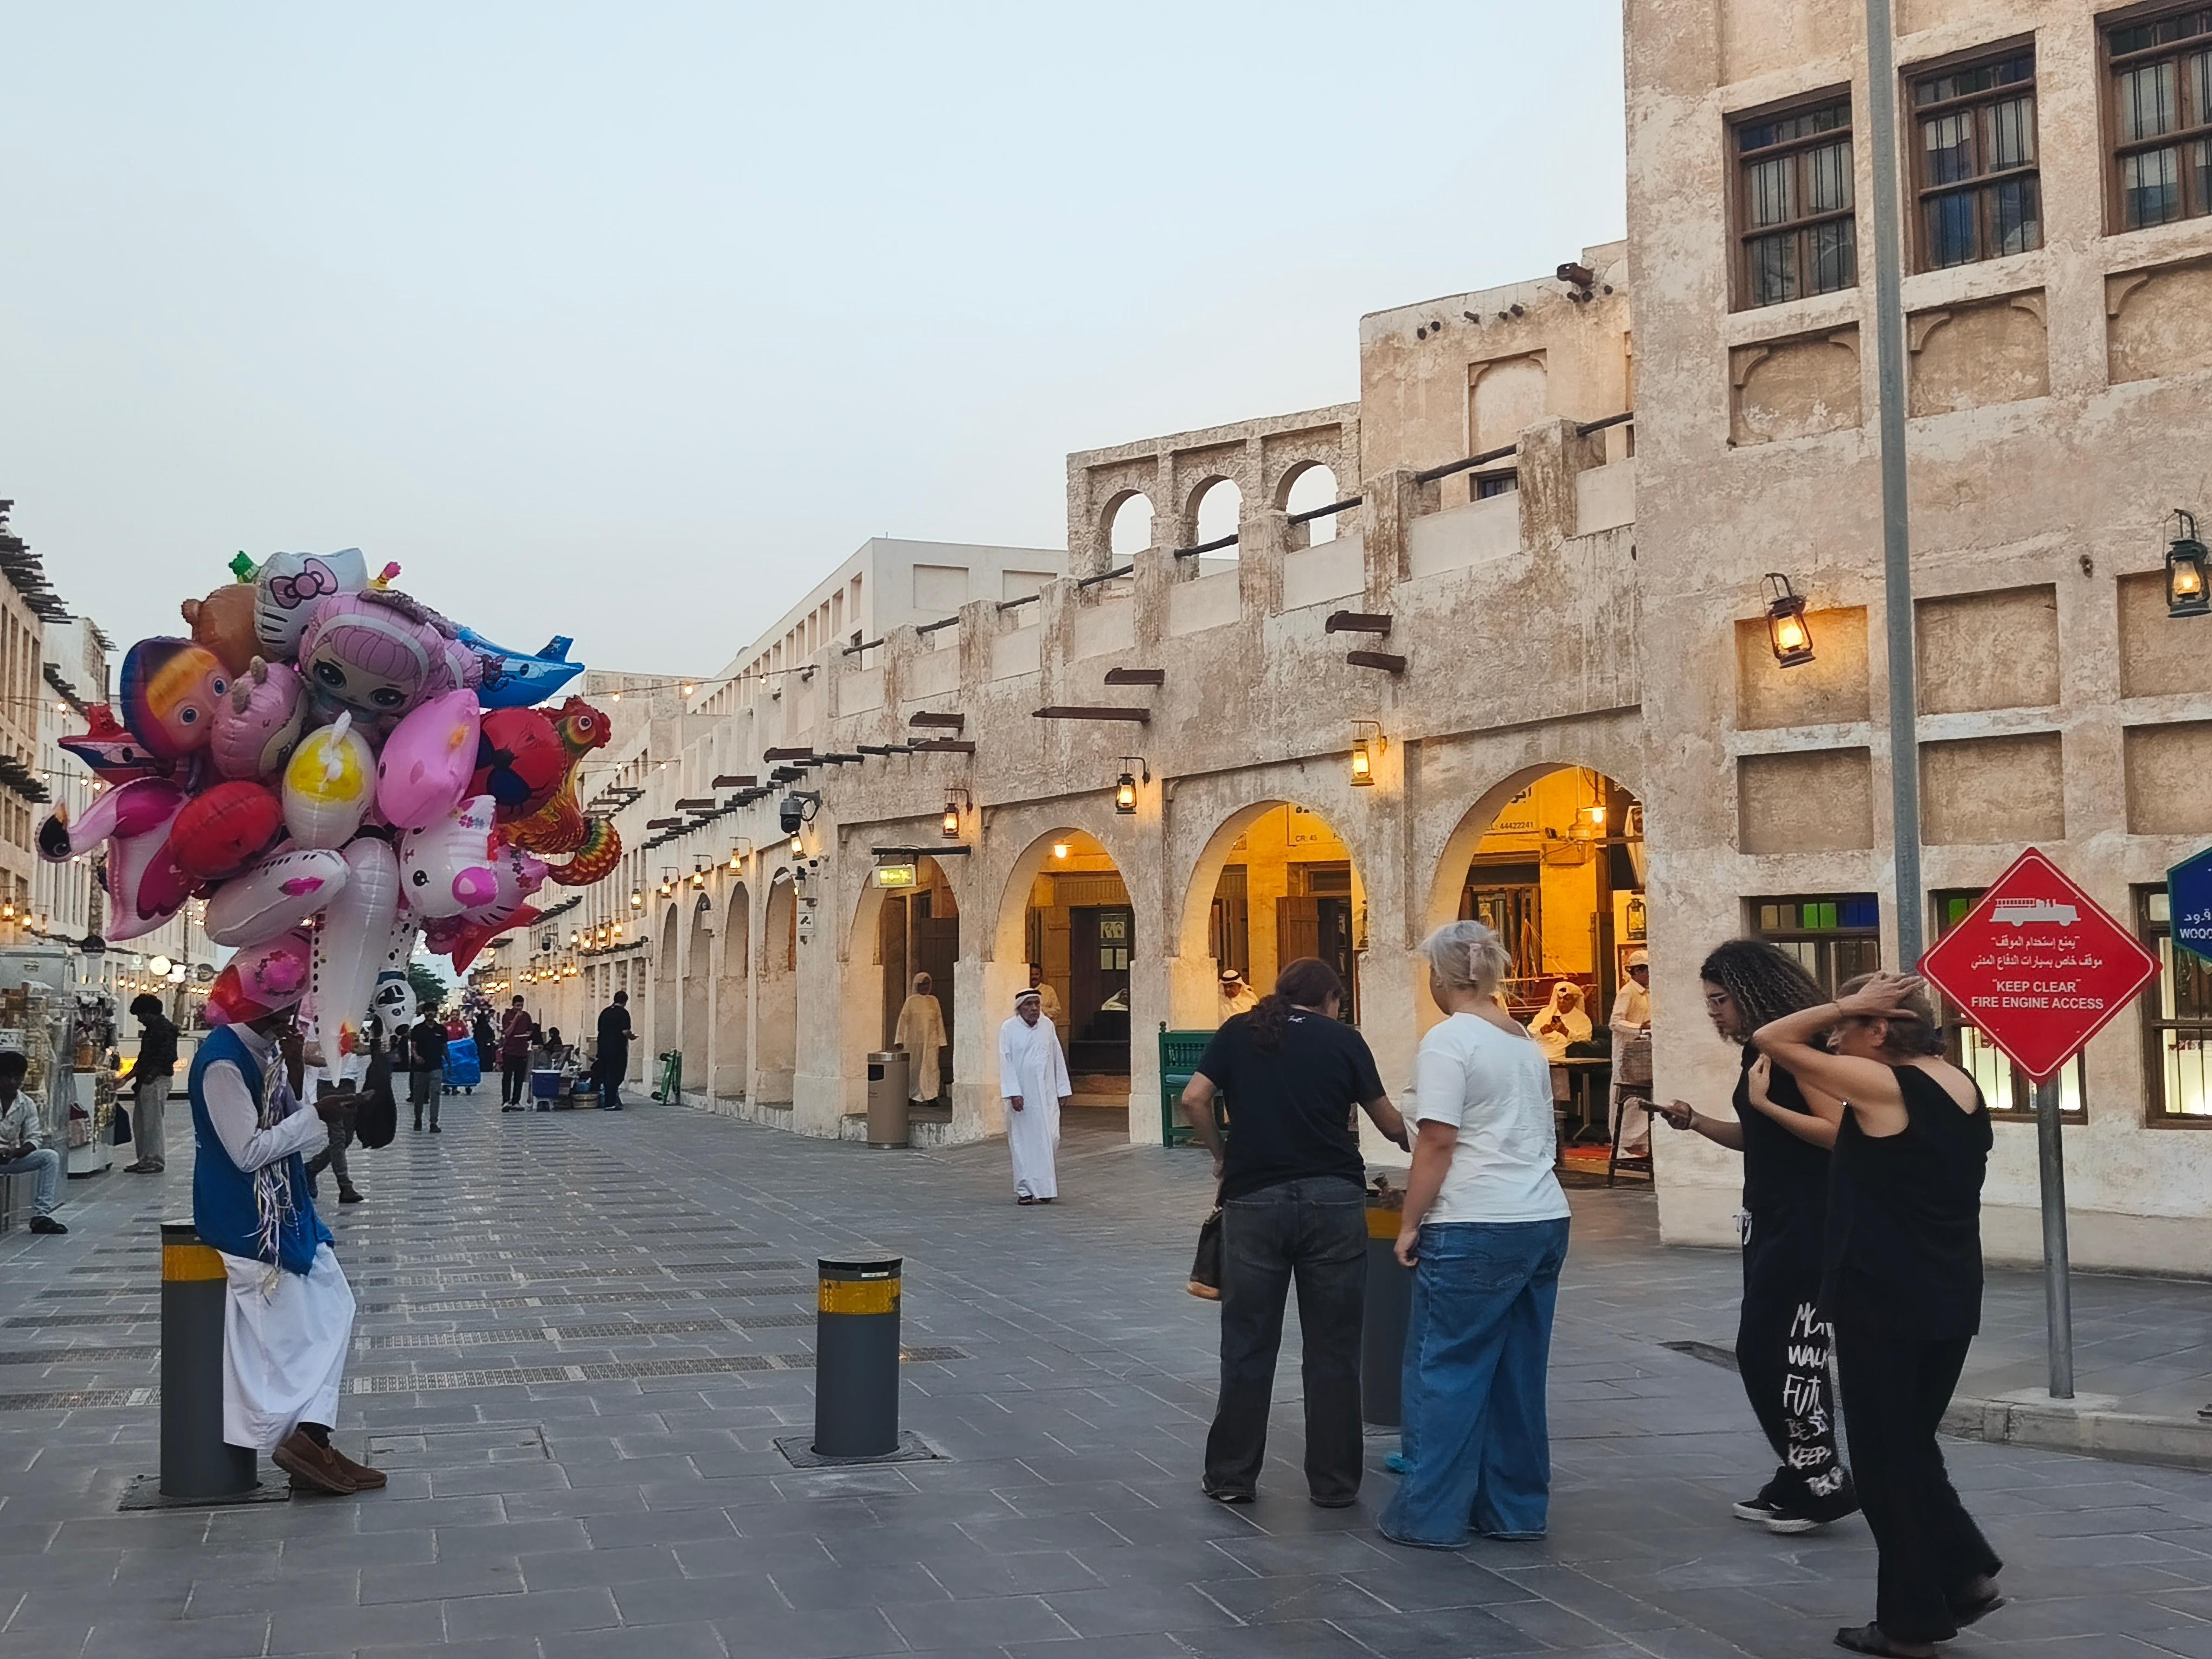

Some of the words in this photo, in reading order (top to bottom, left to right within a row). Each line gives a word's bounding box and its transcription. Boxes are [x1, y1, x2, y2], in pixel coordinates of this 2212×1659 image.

[1500, 821, 1533, 829] 44422241
[2055, 955, 2077, 969] خاص
[2078, 953, 2103, 969] موقف
[1971, 996, 1999, 1007] FIRE
[2002, 997, 2049, 1008] ENGINE
[2052, 998, 2104, 1009] ACCESS
